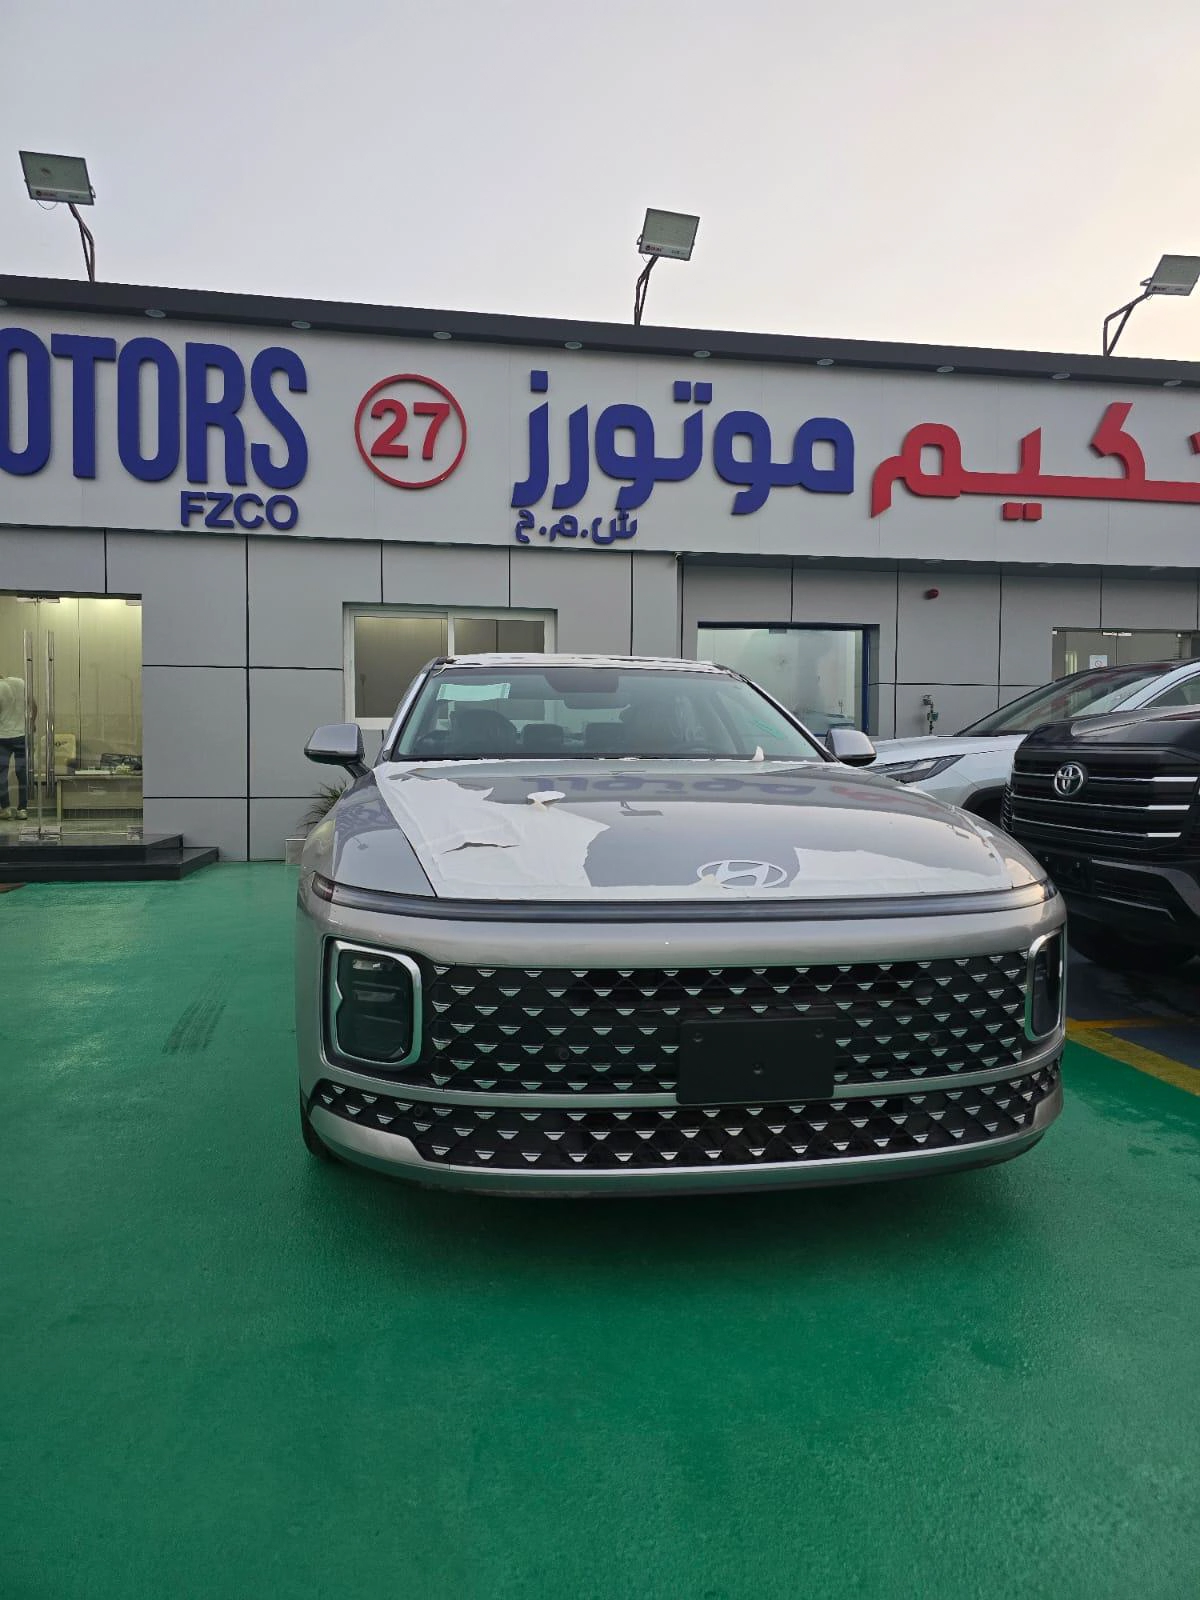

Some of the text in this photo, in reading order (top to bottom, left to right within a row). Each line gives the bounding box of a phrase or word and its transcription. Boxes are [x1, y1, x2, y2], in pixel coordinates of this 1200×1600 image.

[370, 398, 451, 461] 27
[510, 369, 1200, 521] كيم موتورز
[180, 489, 300, 531] FZCO
